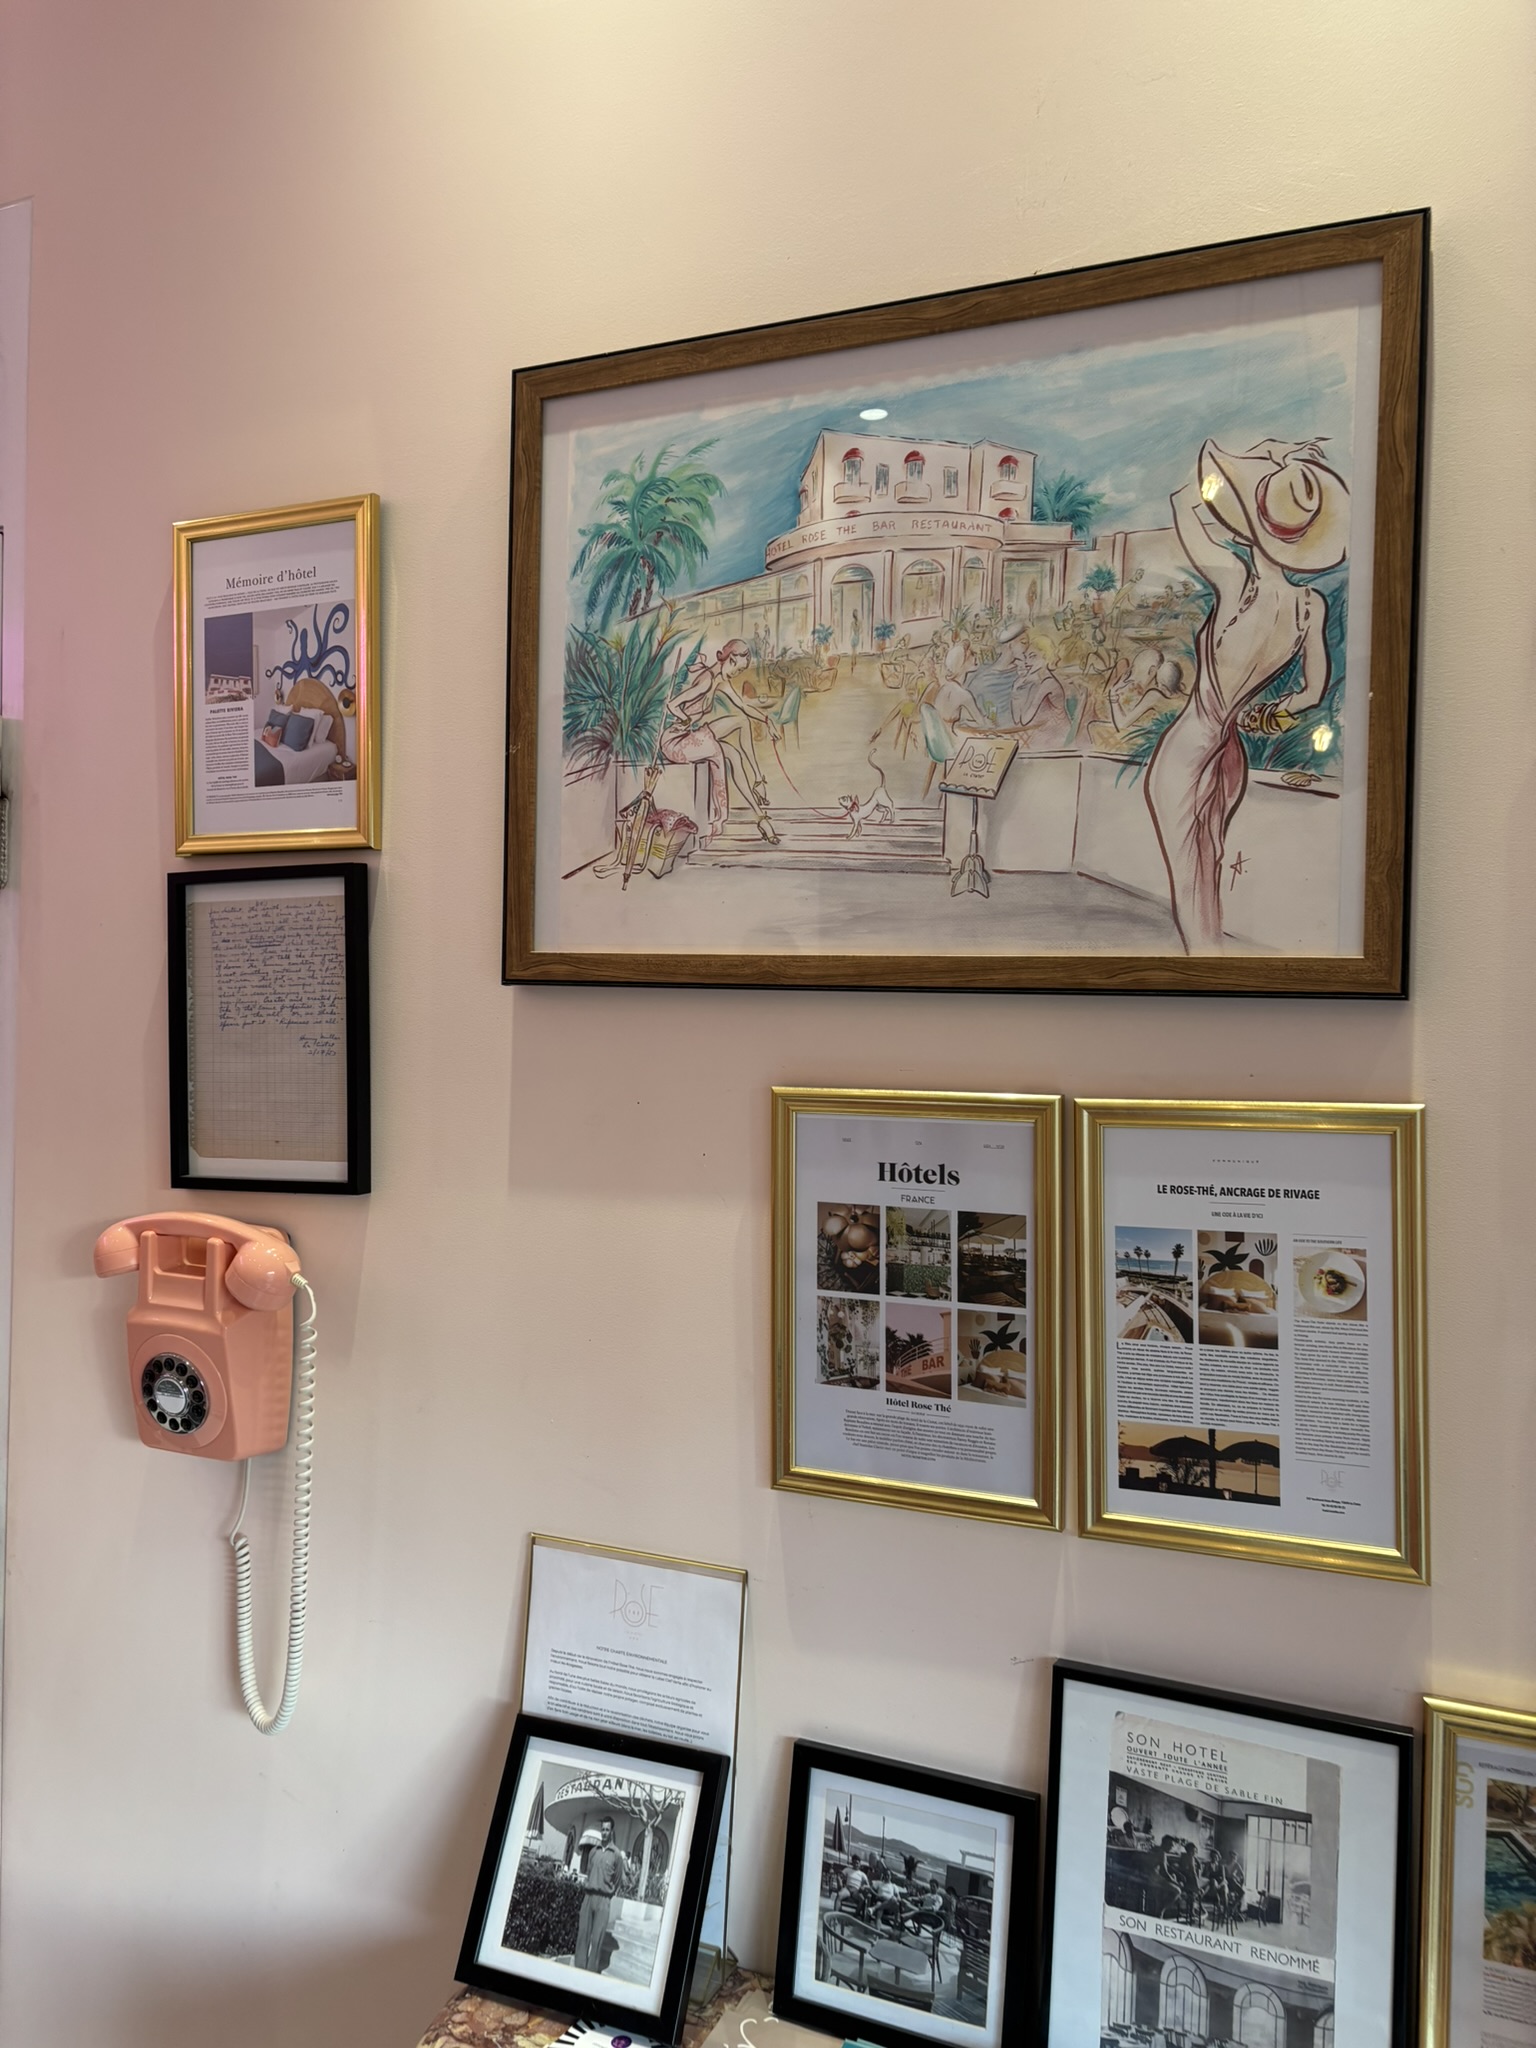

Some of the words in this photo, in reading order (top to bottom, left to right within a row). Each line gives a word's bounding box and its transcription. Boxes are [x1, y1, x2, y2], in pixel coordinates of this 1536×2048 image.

[766, 539, 794, 558] HOTEL
[801, 530, 827, 544] ROSE
[836, 524, 858, 536] THE
[872, 520, 896, 532] BAR
[911, 519, 994, 533] RESTAURANT
[225, 573, 274, 590] Mémoire
[276, 566, 317, 582] d'hôtel
[877, 1162, 961, 1186] Hôtels
[900, 1194, 936, 1205] FRANCE
[1157, 1184, 1168, 1194] LE
[1170, 1184, 1218, 1198] ROSE-THÉ,
[1219, 1186, 1266, 1198] ANCRAGE
[1268, 1188, 1281, 1198] DE
[1283, 1188, 1320, 1200] RIVAGE
[900, 1364, 912, 1378] THE
[921, 1355, 945, 1371] BAR
[885, 1396, 910, 1408] Hôtel
[910, 1400, 932, 1411] Rose
[934, 1402, 952, 1413] Thé
[610, 1648, 626, 1656] CHARTE
[1126, 1731, 1161, 1749] SON
[1172, 1741, 1229, 1763] HOTEL
[1126, 1746, 1157, 1757] OUVERT
[1163, 1753, 1188, 1764] TOUTE
[1194, 1759, 1228, 1772] L'ANNÉE
[1126, 1766, 1159, 1780] VASTE
[1164, 1773, 1200, 1788] PLAGE
[1205, 1782, 1219, 1793] DE
[1224, 1786, 1259, 1801] SABLE
[1264, 1794, 1284, 1806] FIN
[1119, 1915, 1147, 1933] SON
[1154, 1920, 1242, 1955] RESTAURANT
[1250, 1945, 1321, 1974] RENOMMÉ
